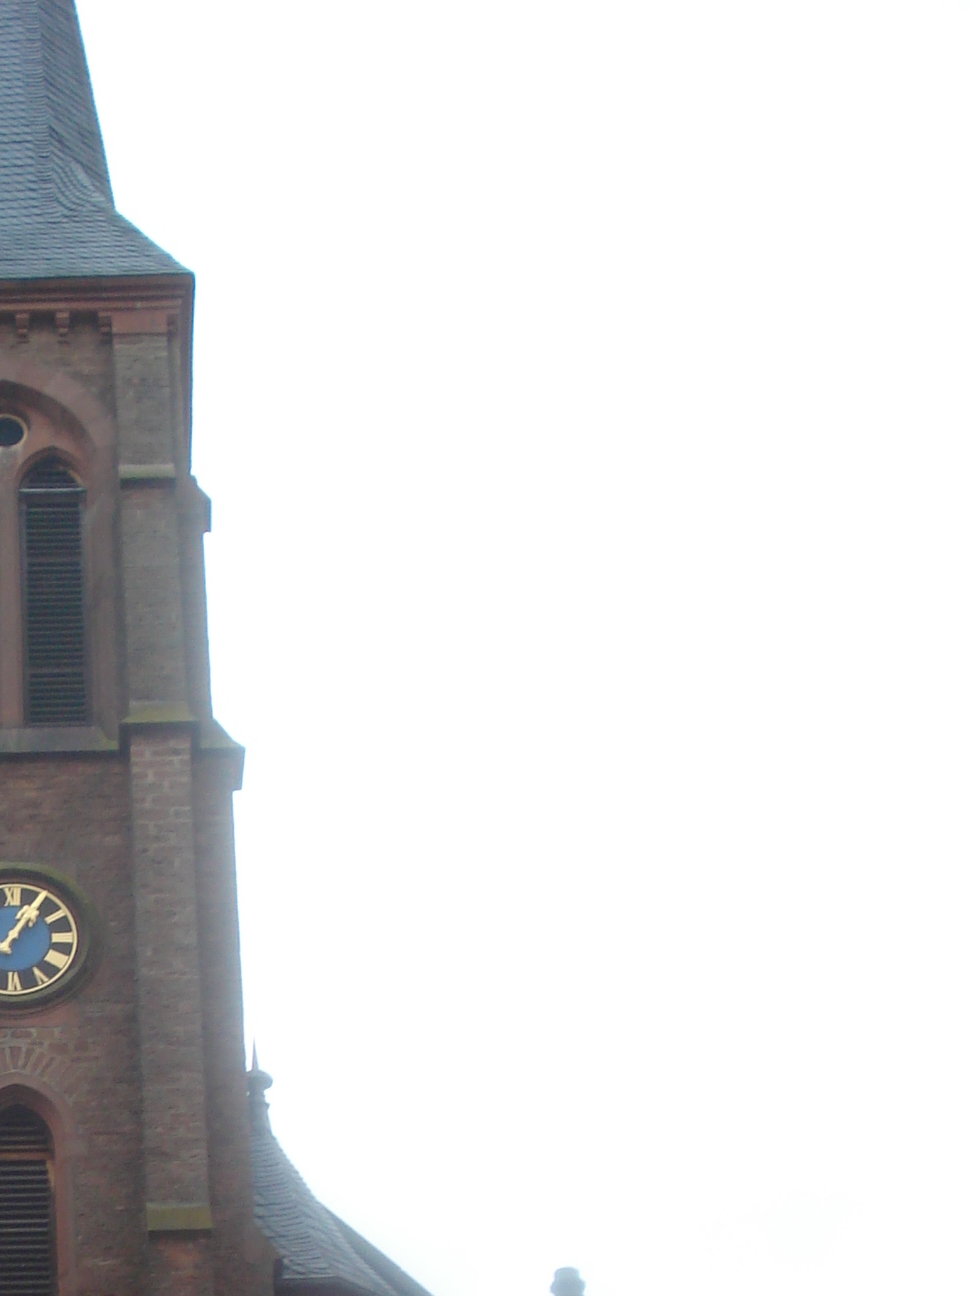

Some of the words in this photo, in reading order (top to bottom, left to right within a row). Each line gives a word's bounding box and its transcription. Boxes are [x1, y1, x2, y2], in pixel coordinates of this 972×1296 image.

[4, 887, 21, 907] XII
[43, 909, 67, 925] II
[7, 971, 22, 991] VI
[32, 966, 50, 986] V
